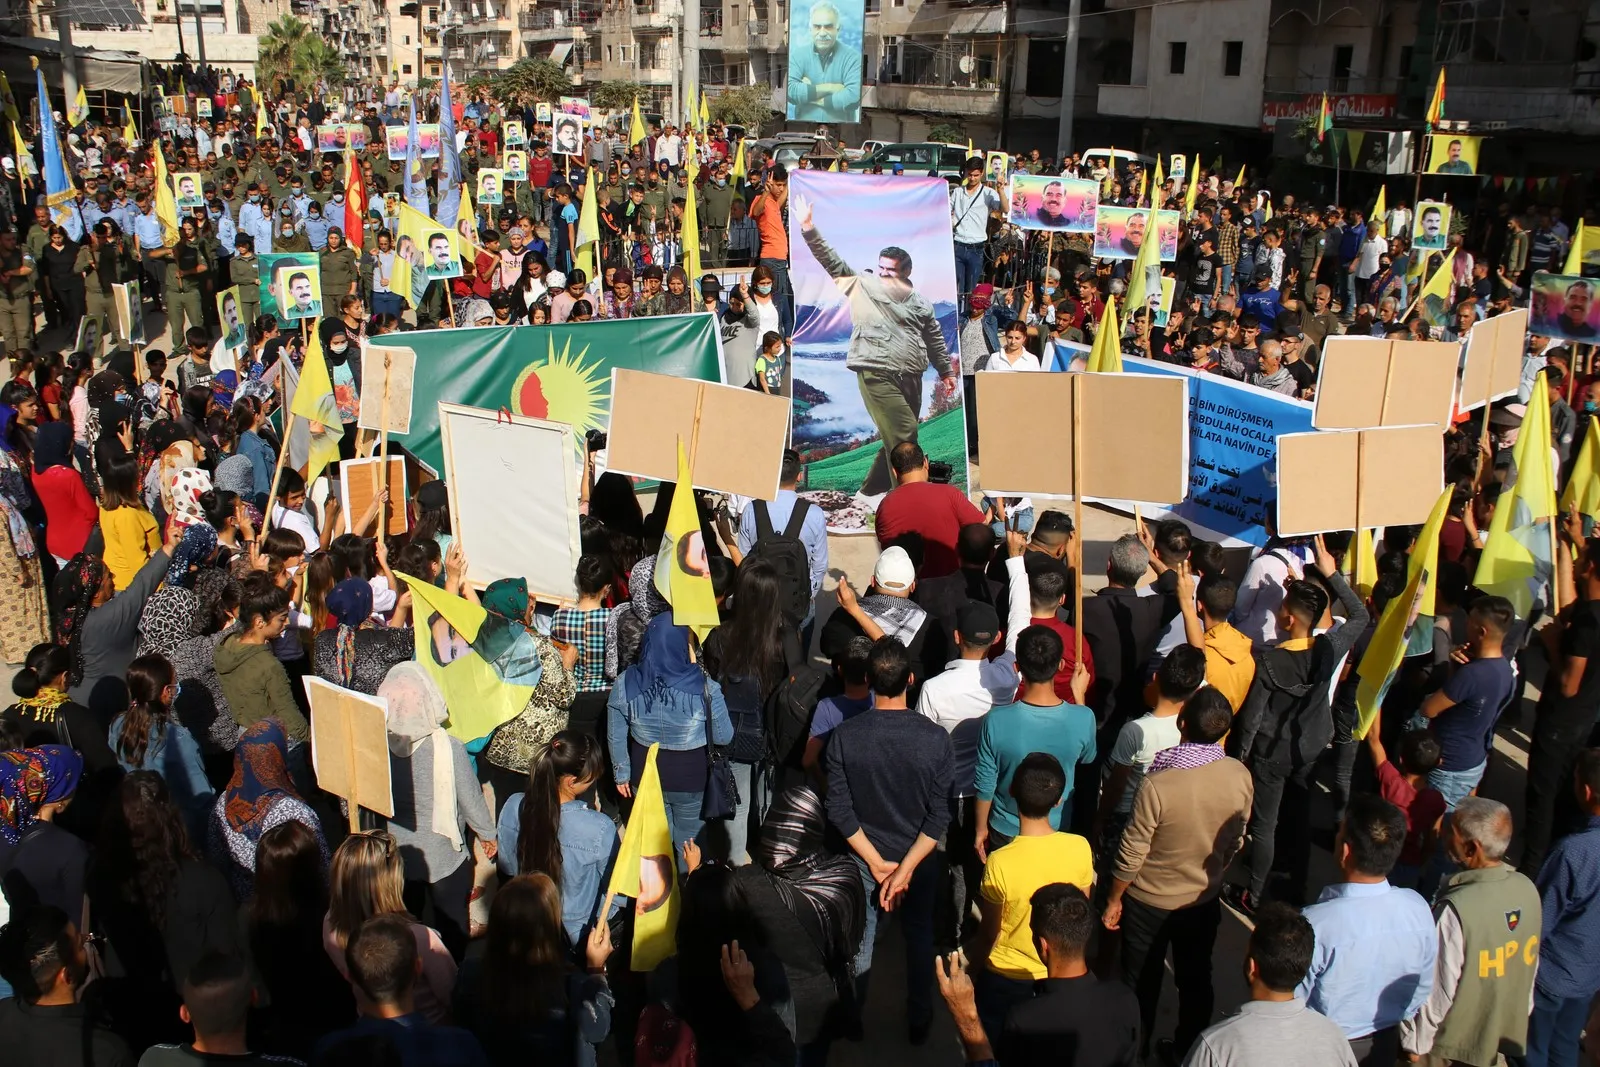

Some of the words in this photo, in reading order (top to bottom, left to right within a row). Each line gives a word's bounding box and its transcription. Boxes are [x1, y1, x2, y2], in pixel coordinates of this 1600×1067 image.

[1241, 428, 1276, 446] OCALA
[1257, 446, 1271, 458] DE
[1191, 455, 1215, 470] شعار
[1218, 464, 1240, 478] تحت
